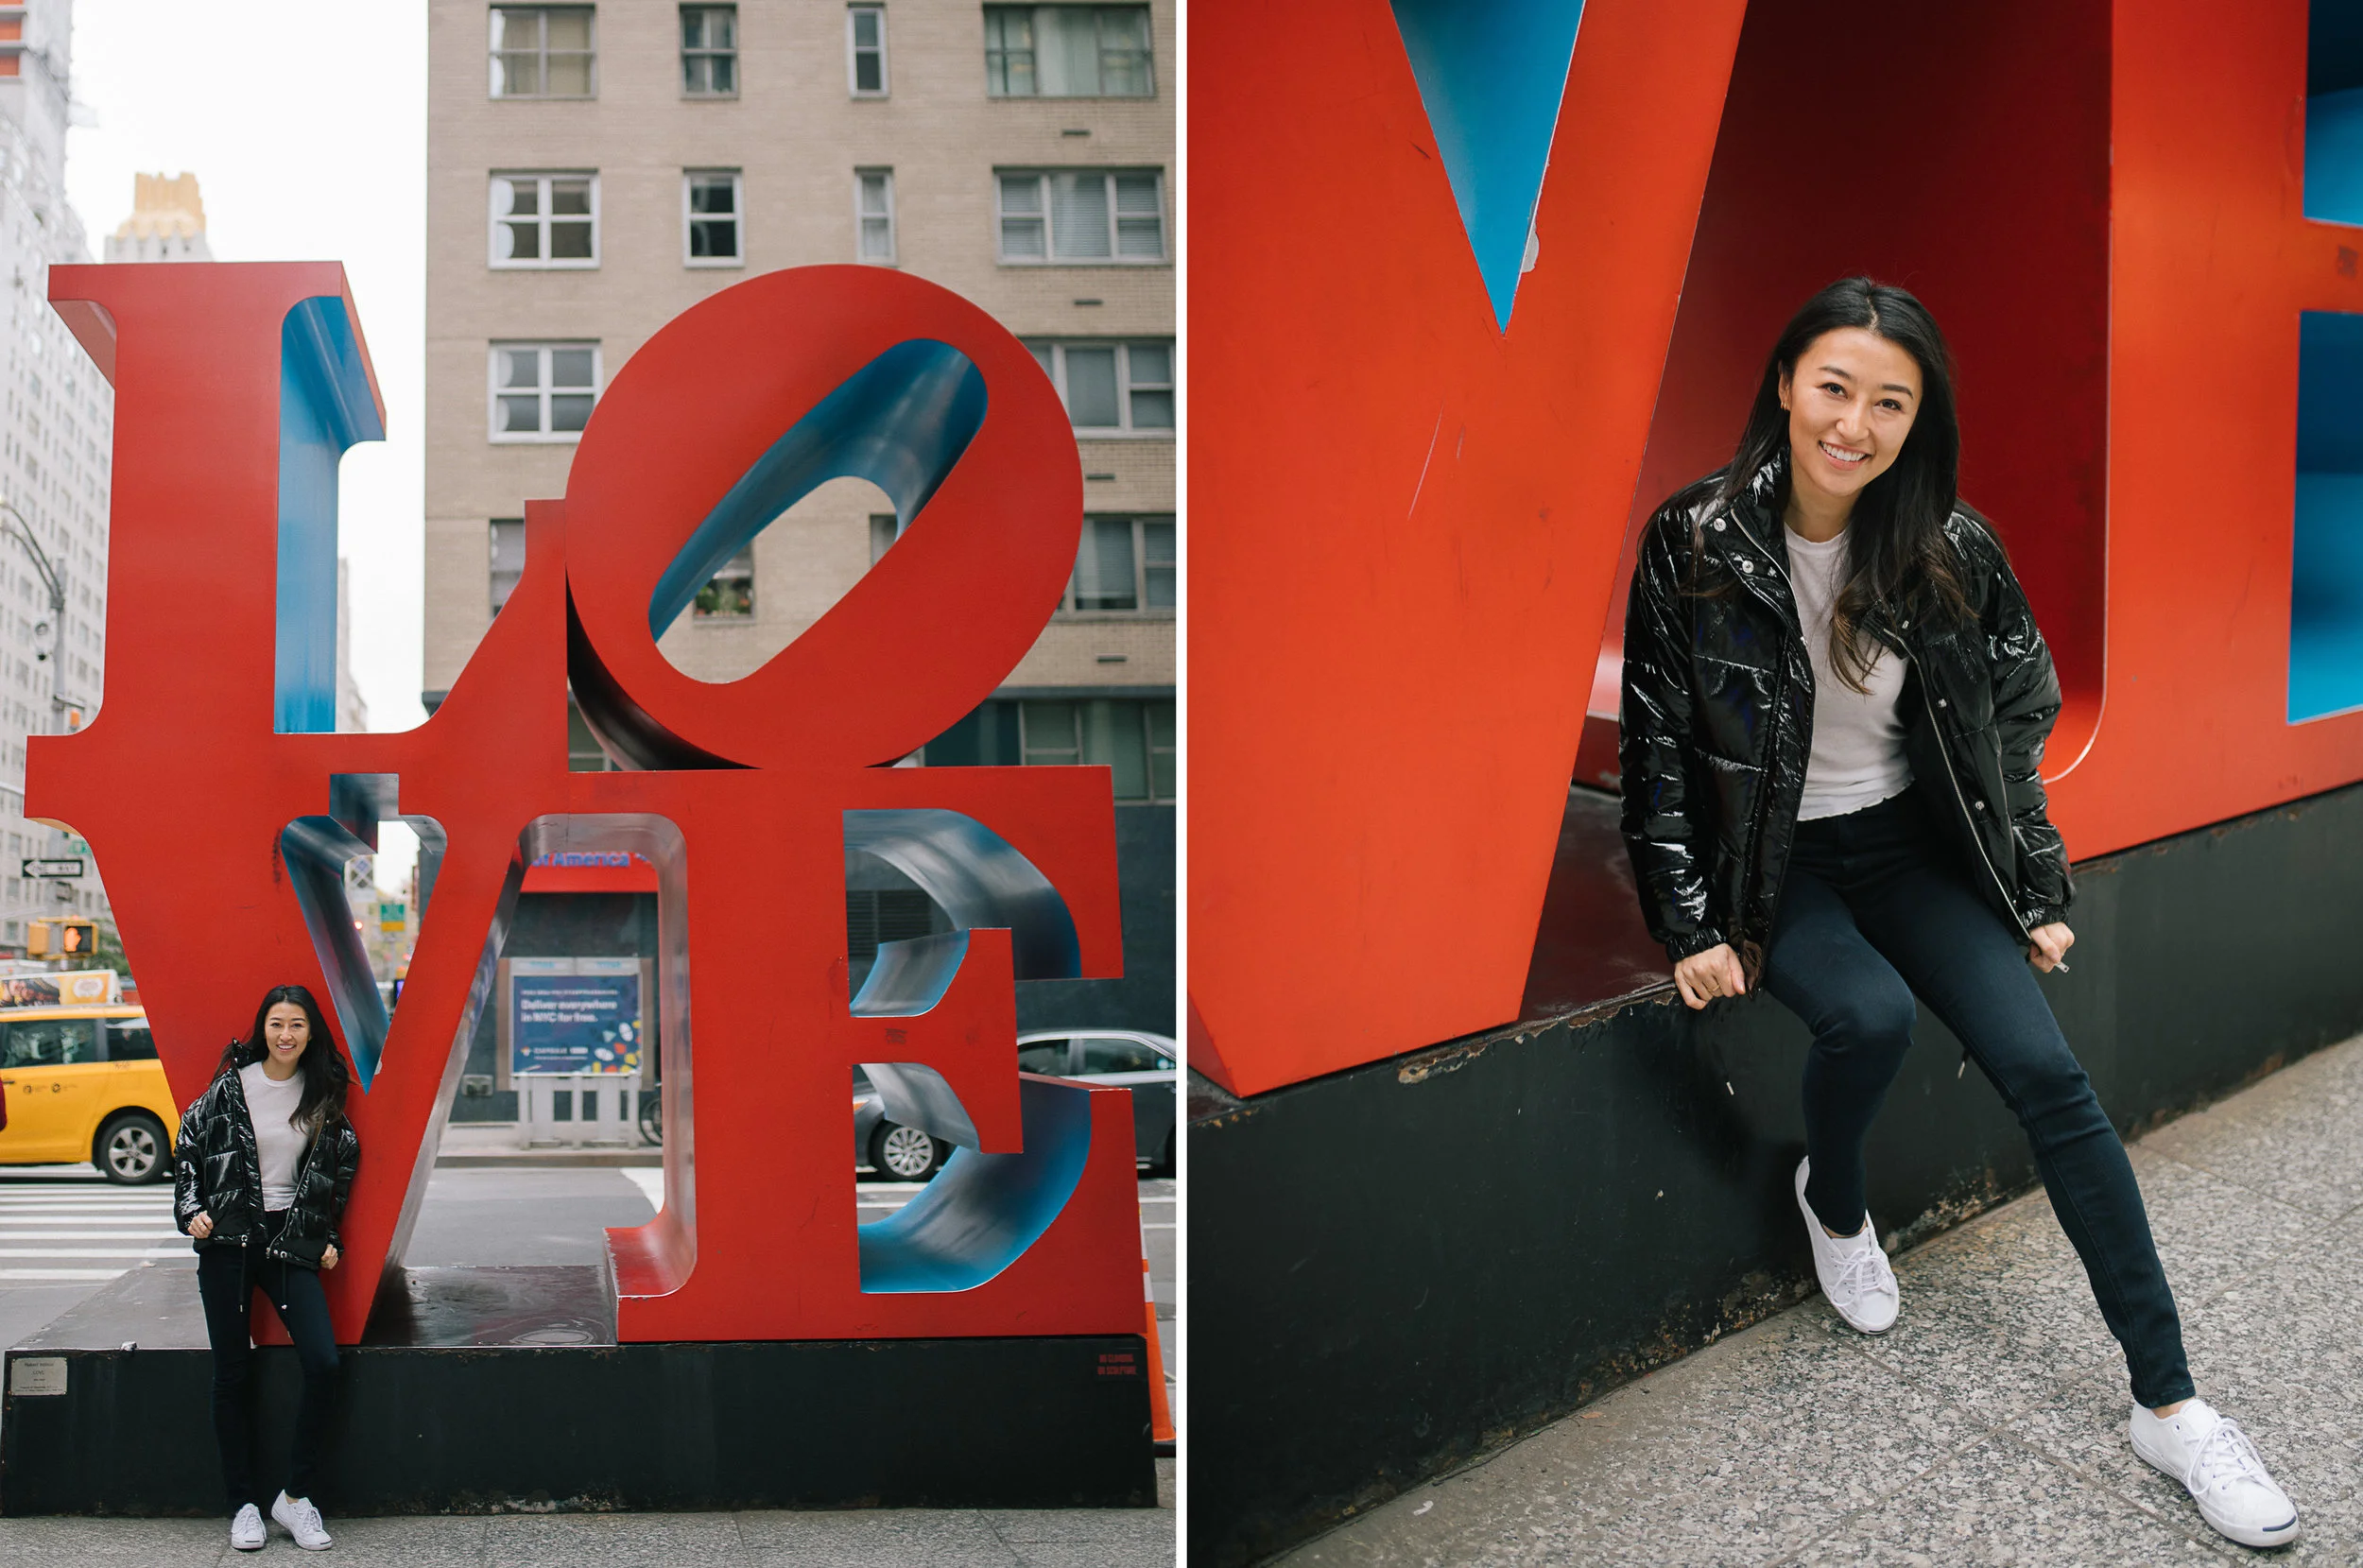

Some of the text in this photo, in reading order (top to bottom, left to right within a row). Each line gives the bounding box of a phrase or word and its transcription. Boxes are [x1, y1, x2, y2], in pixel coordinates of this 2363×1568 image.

[552, 853, 631, 868] America
[521, 999, 618, 1012] Deliver everywhere
[521, 1012, 532, 1023] in
[533, 1012, 557, 1023] NYC
[558, 1012, 573, 1023] for
